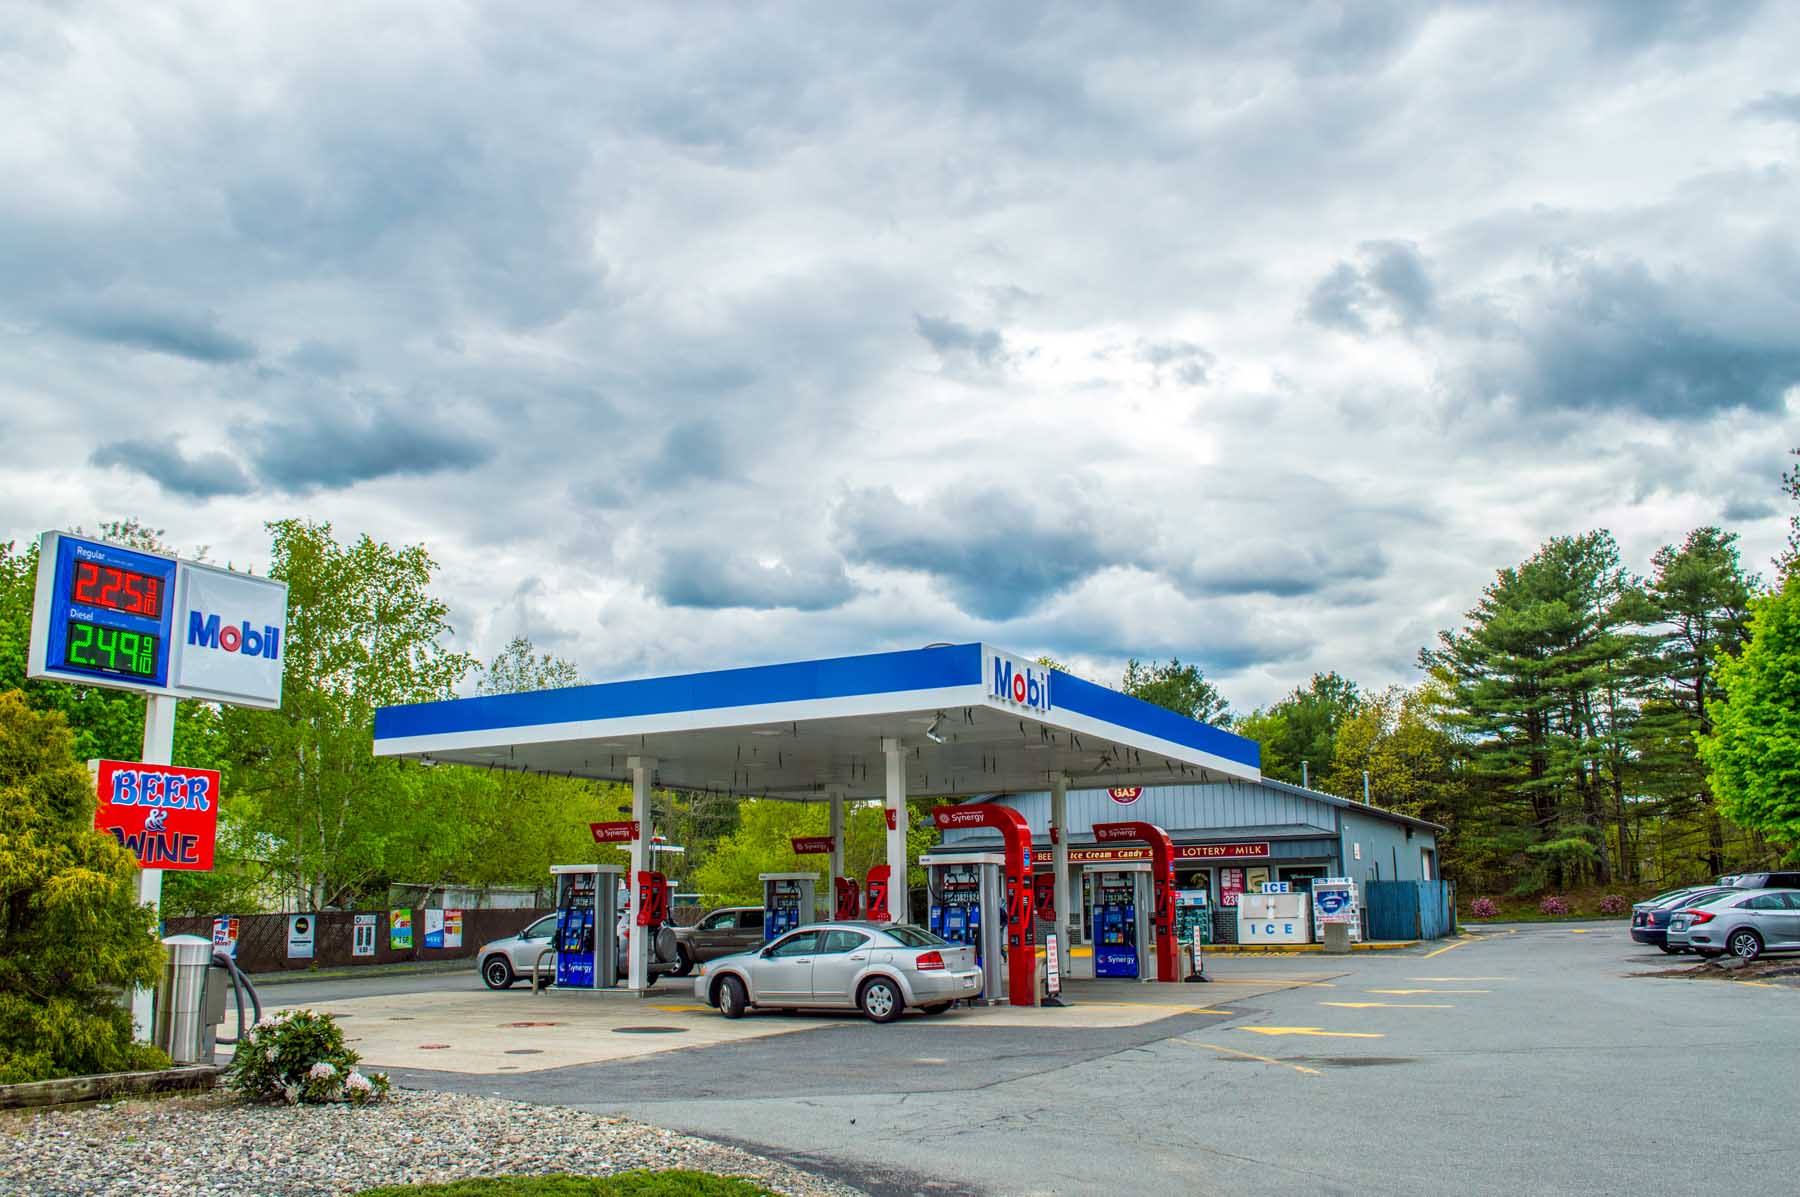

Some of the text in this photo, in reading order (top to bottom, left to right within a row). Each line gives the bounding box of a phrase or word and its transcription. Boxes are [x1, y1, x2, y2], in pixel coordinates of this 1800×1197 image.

[77, 546, 105, 560] Regular
[70, 608, 94, 620] Diesel
[188, 610, 280, 660] Mobil
[70, 624, 140, 672] 2.49
[994, 656, 1051, 710] Mobil
[111, 769, 210, 812] BEER
[1114, 788, 1136, 798] GAS
[145, 808, 168, 832] &
[952, 814, 984, 823] Synergy
[604, 830, 630, 838] Synergy
[1108, 829, 1136, 837] Synergy
[107, 826, 200, 864] WINE
[1038, 852, 1052, 861] BEE
[1118, 850, 1143, 858] Candy
[1182, 846, 1262, 856] LOTTERY MILK
[1264, 883, 1288, 893] ICE
[1251, 924, 1293, 934] ICE
[1108, 955, 1135, 965] Synergy
